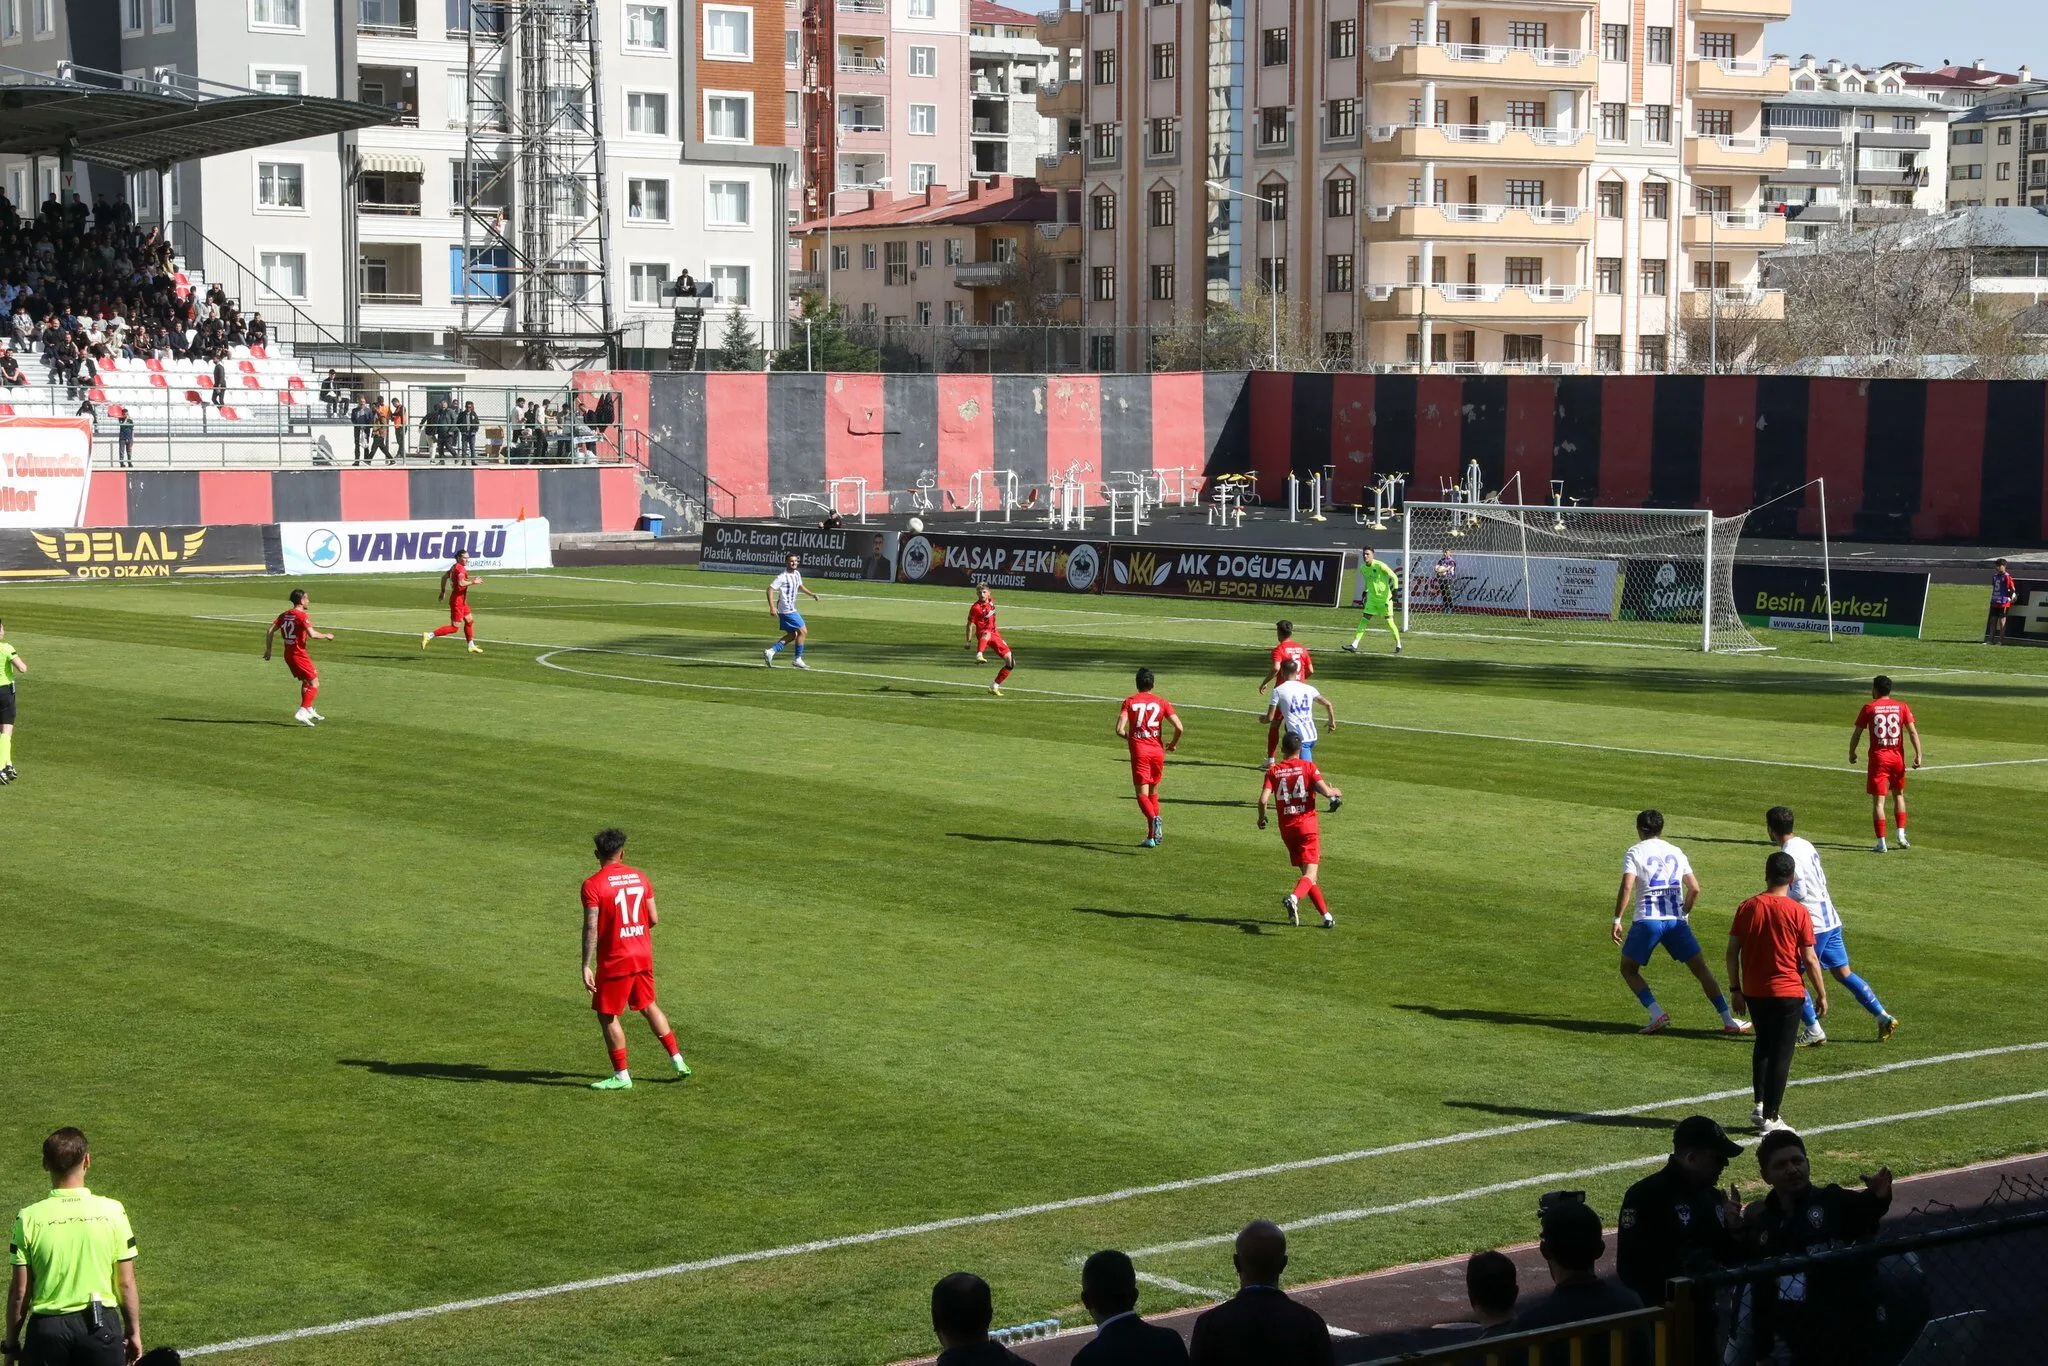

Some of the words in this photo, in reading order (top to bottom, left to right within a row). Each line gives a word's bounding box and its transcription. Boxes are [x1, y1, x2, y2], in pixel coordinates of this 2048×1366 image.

[2, 452, 84, 477] Yolunda
[0, 486, 38, 512] ller
[64, 531, 178, 562] DELAL
[347, 525, 507, 562] VANGÖLÜ
[716, 528, 748, 546] Op.Dr.
[750, 530, 778, 547] Ercan
[780, 529, 846, 550] ÇELİKKALELİ
[703, 546, 734, 562] Plastik,
[802, 552, 832, 566] Estetik
[833, 554, 863, 568] Cerrah
[944, 546, 1006, 570] KASAP
[1011, 545, 1057, 574] ZEKİ
[1176, 553, 1212, 575] MK
[1217, 554, 1325, 582] DOĞUSAN
[77, 565, 110, 578] OTO
[970, 572, 1025, 587] STEAKHOUSE
[1187, 579, 1215, 595] YAPI
[1219, 582, 1257, 597] SPOR
[1756, 591, 1805, 613] Besin
[1811, 594, 1888, 618] Merkezi
[281, 620, 296, 639] 12
[1132, 702, 1161, 728] 72
[1874, 713, 1900, 738] 88
[1276, 774, 1309, 804] 44
[1646, 854, 1680, 887] 22
[614, 886, 645, 924] 17
[619, 925, 645, 938] ALPAY
